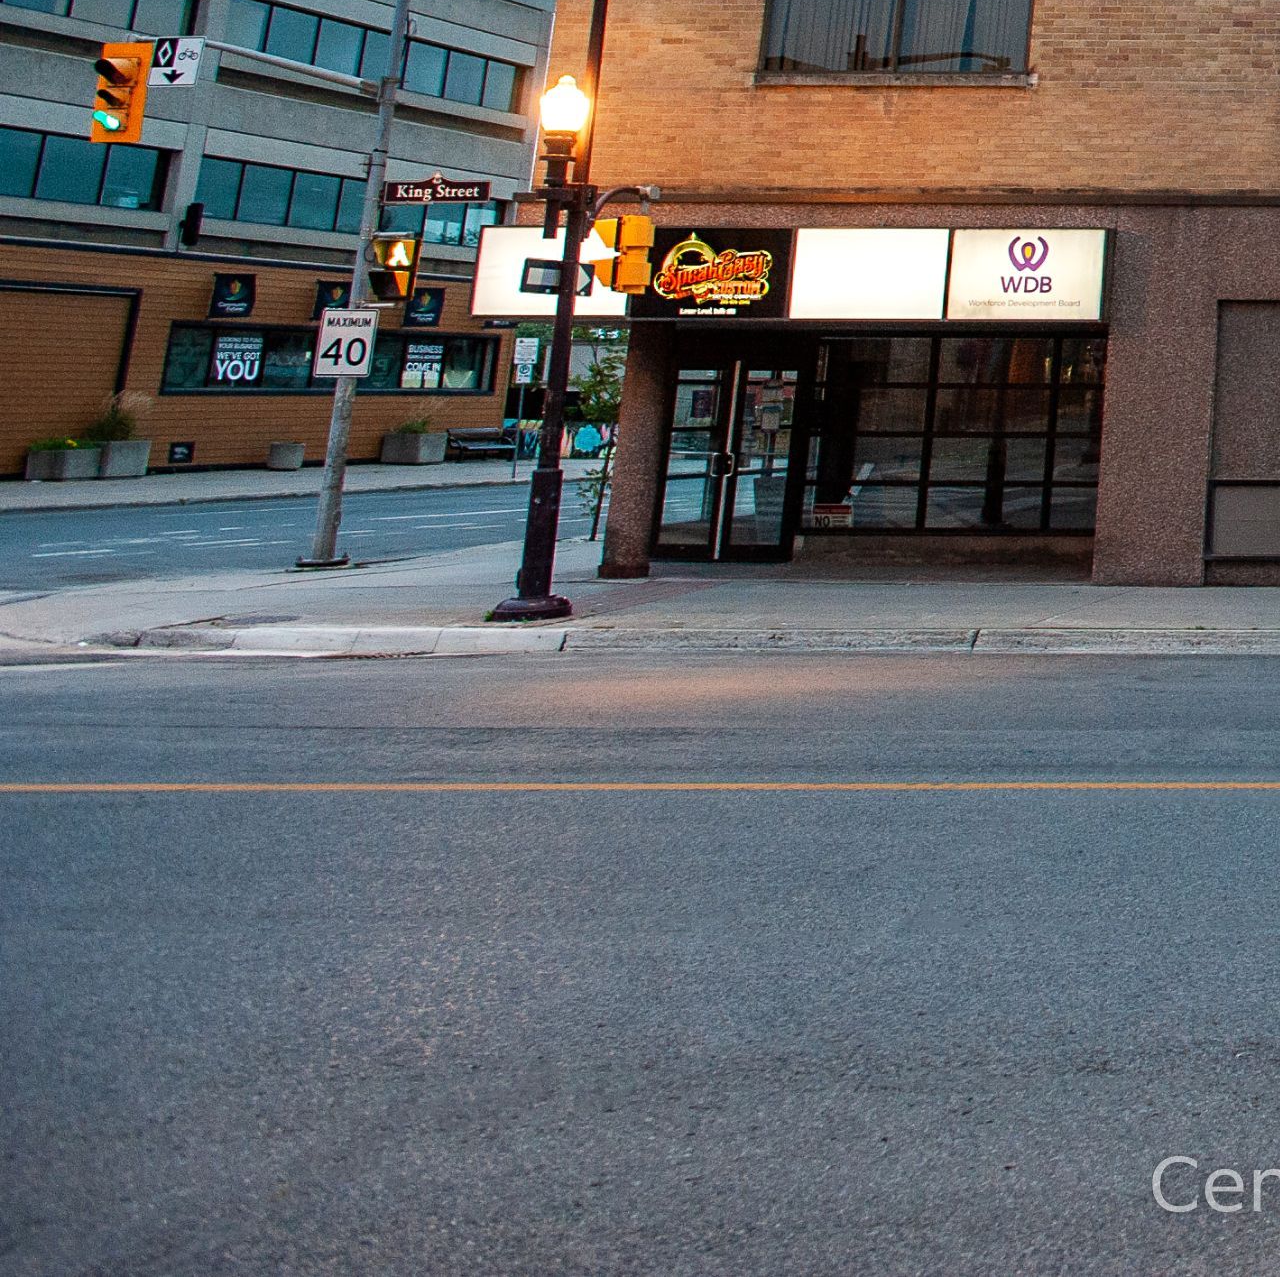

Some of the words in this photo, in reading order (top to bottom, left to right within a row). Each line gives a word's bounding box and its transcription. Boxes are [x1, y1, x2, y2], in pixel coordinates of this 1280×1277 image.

[396, 184, 433, 201] King
[435, 184, 480, 198] Street
[1000, 275, 1053, 294] WDB
[968, 299, 1006, 308] Workforce
[1007, 299, 1057, 310] Development
[1058, 299, 1081, 308] Board
[326, 317, 372, 328] MAXIMUM
[243, 352, 261, 360] GOT
[320, 337, 367, 367] 40
[215, 359, 260, 381] YOU
[406, 362, 432, 372] COME
[432, 362, 442, 372] IN
[815, 515, 830, 528] NO
